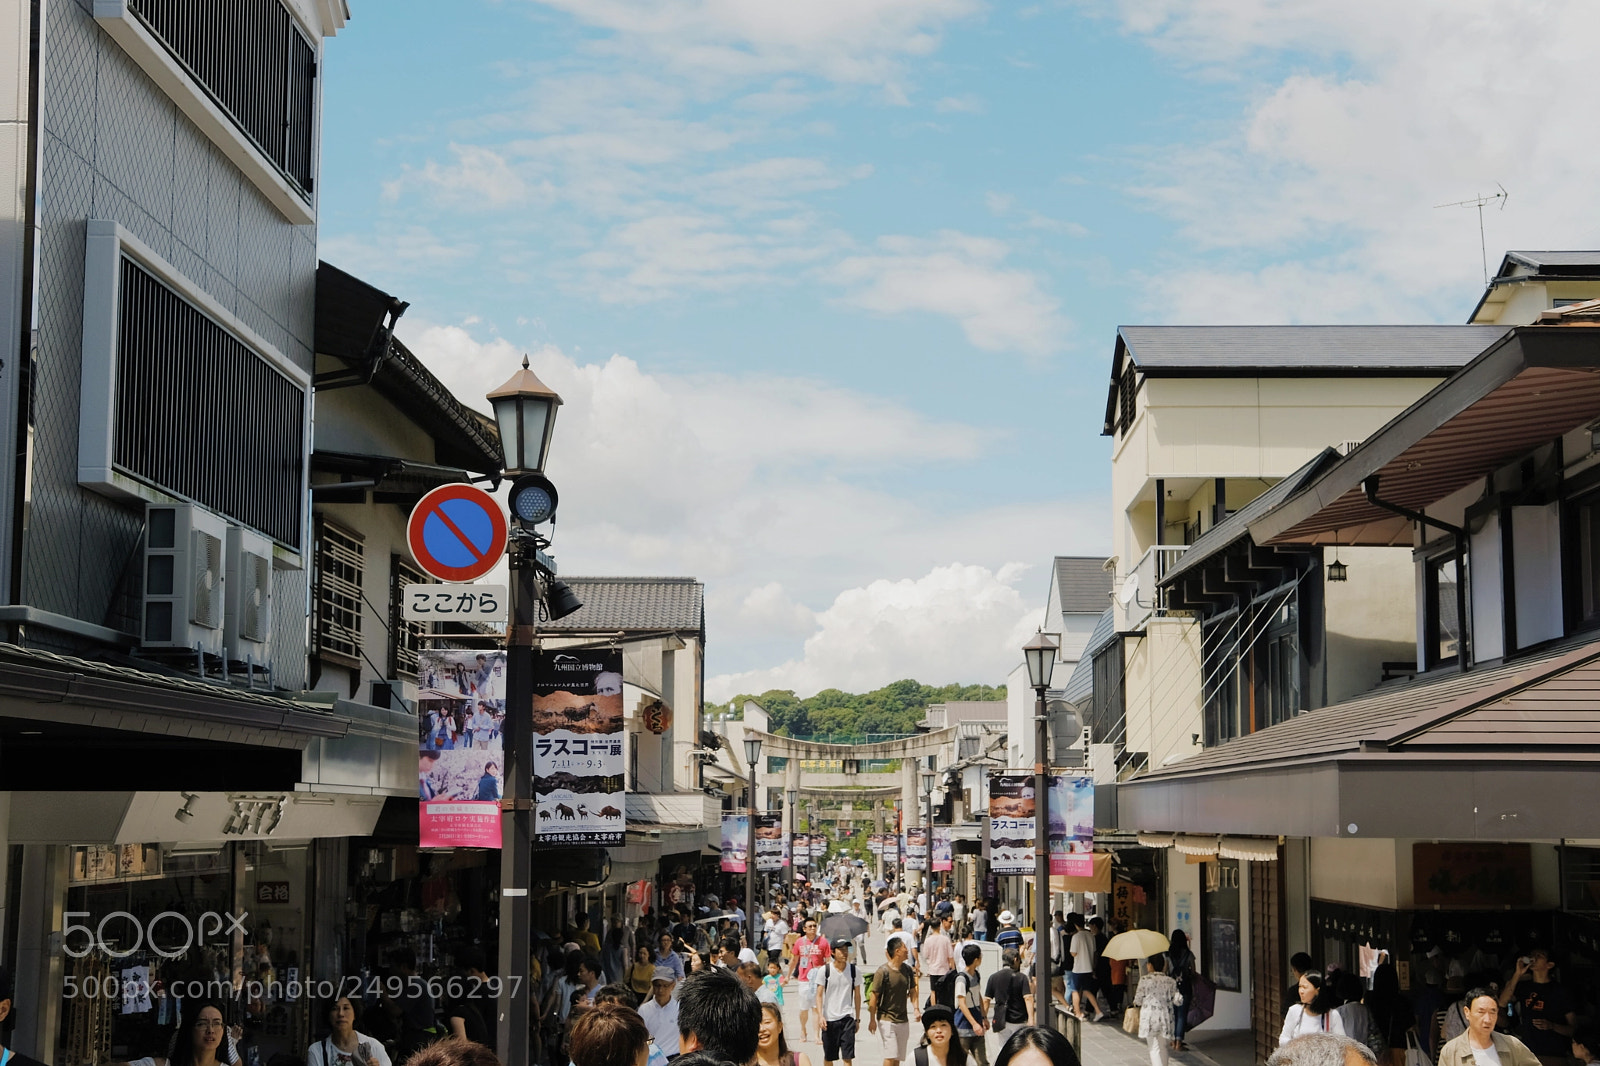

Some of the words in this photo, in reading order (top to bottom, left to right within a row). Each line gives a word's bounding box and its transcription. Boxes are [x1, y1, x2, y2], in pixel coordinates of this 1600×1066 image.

[412, 592, 498, 614] ここから
[553, 663, 604, 671] 九州国立博物館
[535, 738, 622, 758] ラスコー展
[258, 885, 289, 901] 合格
